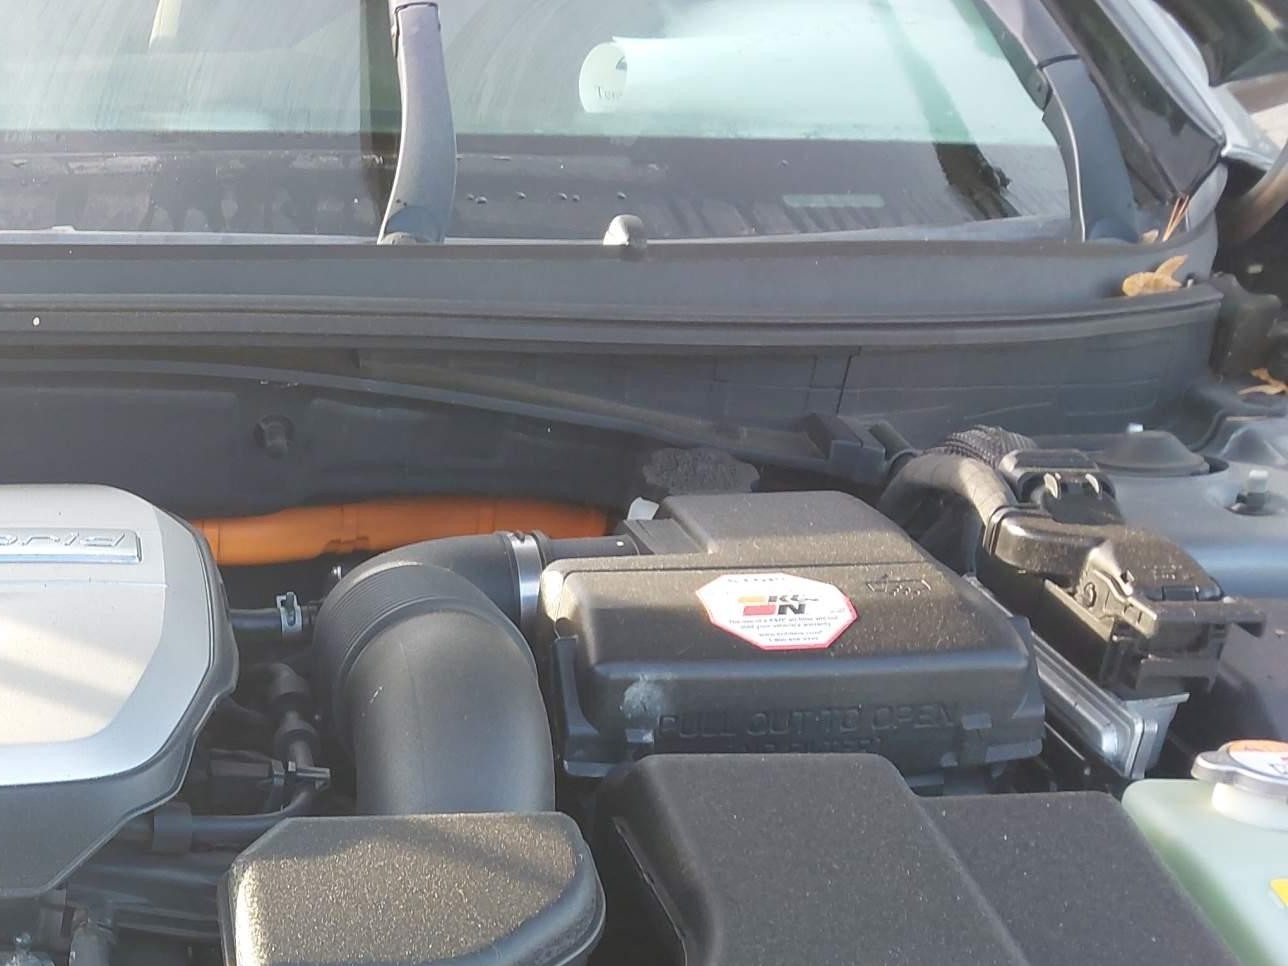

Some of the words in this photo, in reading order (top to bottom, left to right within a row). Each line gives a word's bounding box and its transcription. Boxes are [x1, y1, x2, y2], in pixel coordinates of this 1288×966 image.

[659, 713, 736, 738] PULL
[748, 711, 812, 735] OUT
[819, 708, 860, 733] TO
[872, 704, 955, 731] OPEN
